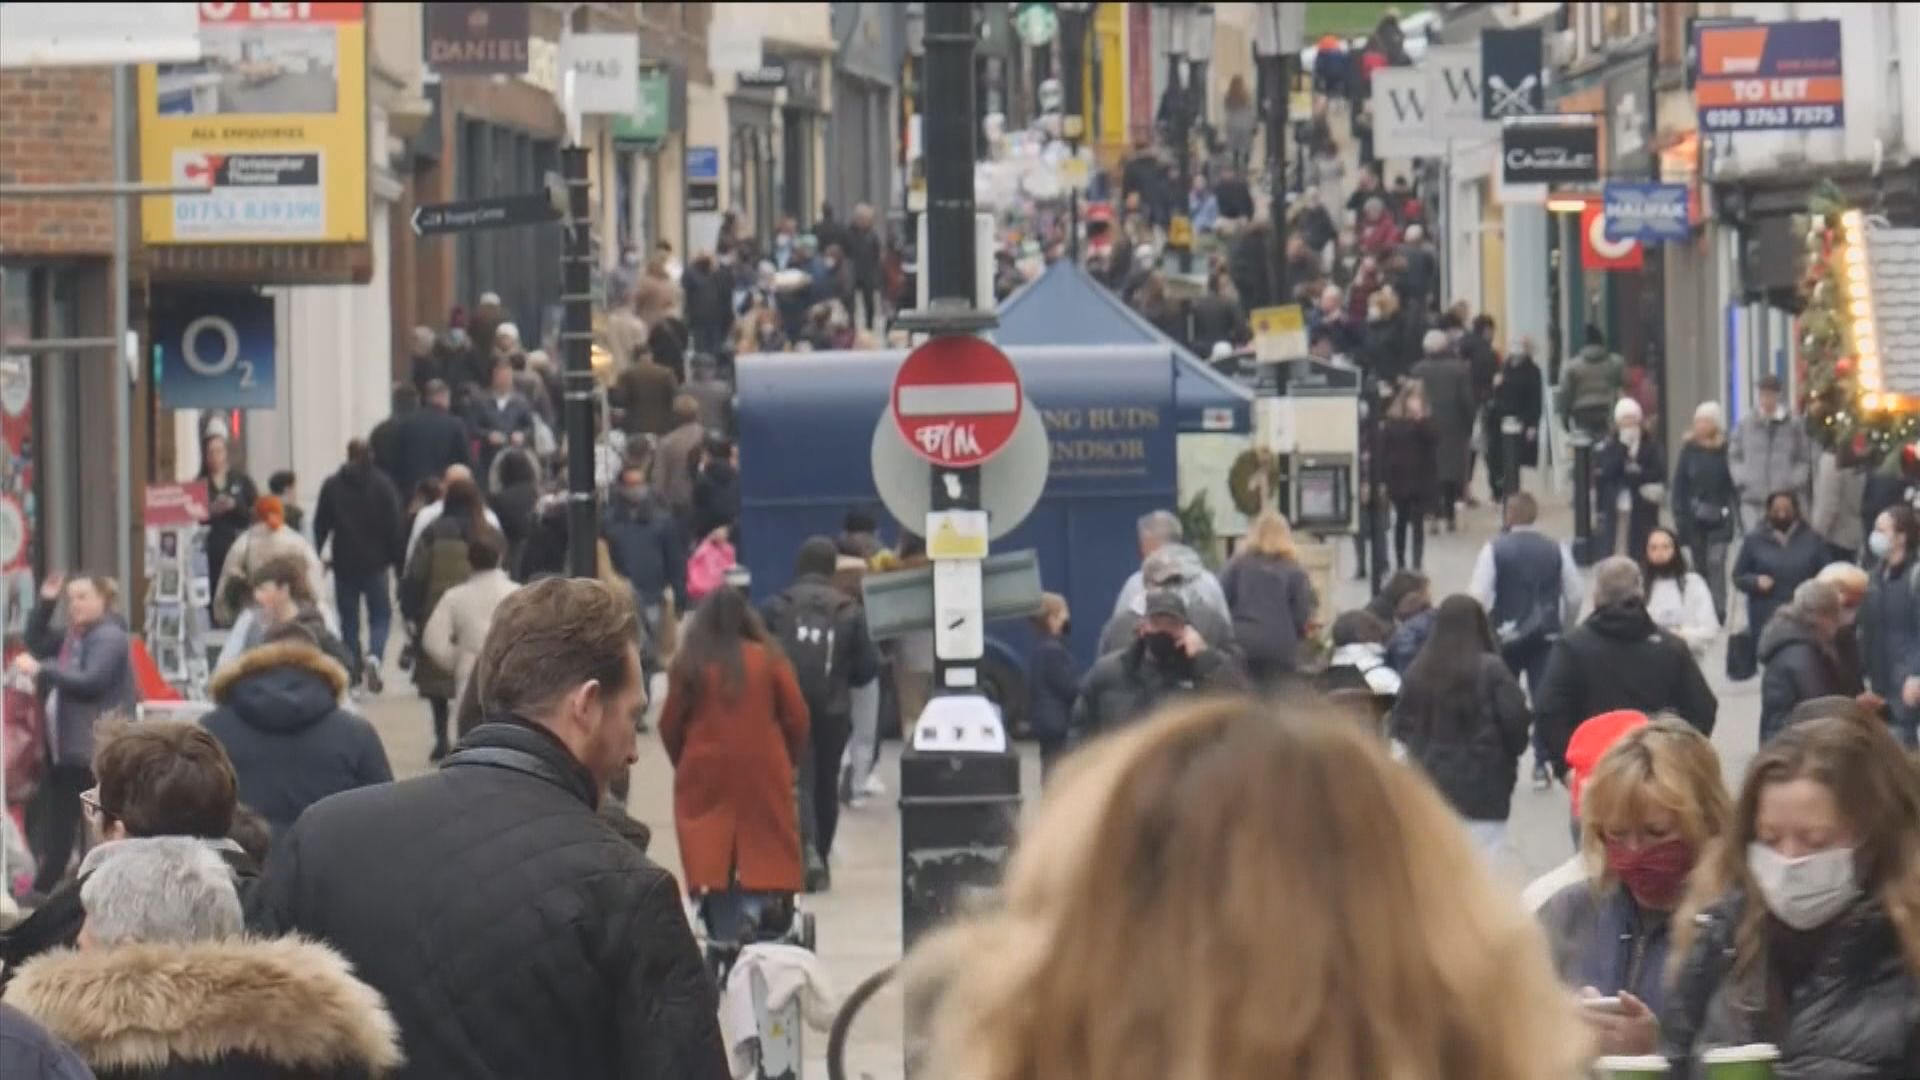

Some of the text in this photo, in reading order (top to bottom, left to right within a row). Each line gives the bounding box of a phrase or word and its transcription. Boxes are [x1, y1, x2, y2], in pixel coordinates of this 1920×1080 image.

[431, 39, 526, 62] DANIEL
[1732, 78, 1808, 103] TO LET
[1389, 88, 1427, 122] W
[1706, 109, 1741, 127] 020
[1792, 106, 1835, 124] 7575
[192, 128, 217, 139] ALL
[1607, 201, 1685, 218] HALIFAX
[1088, 407, 1159, 431] BUDS
